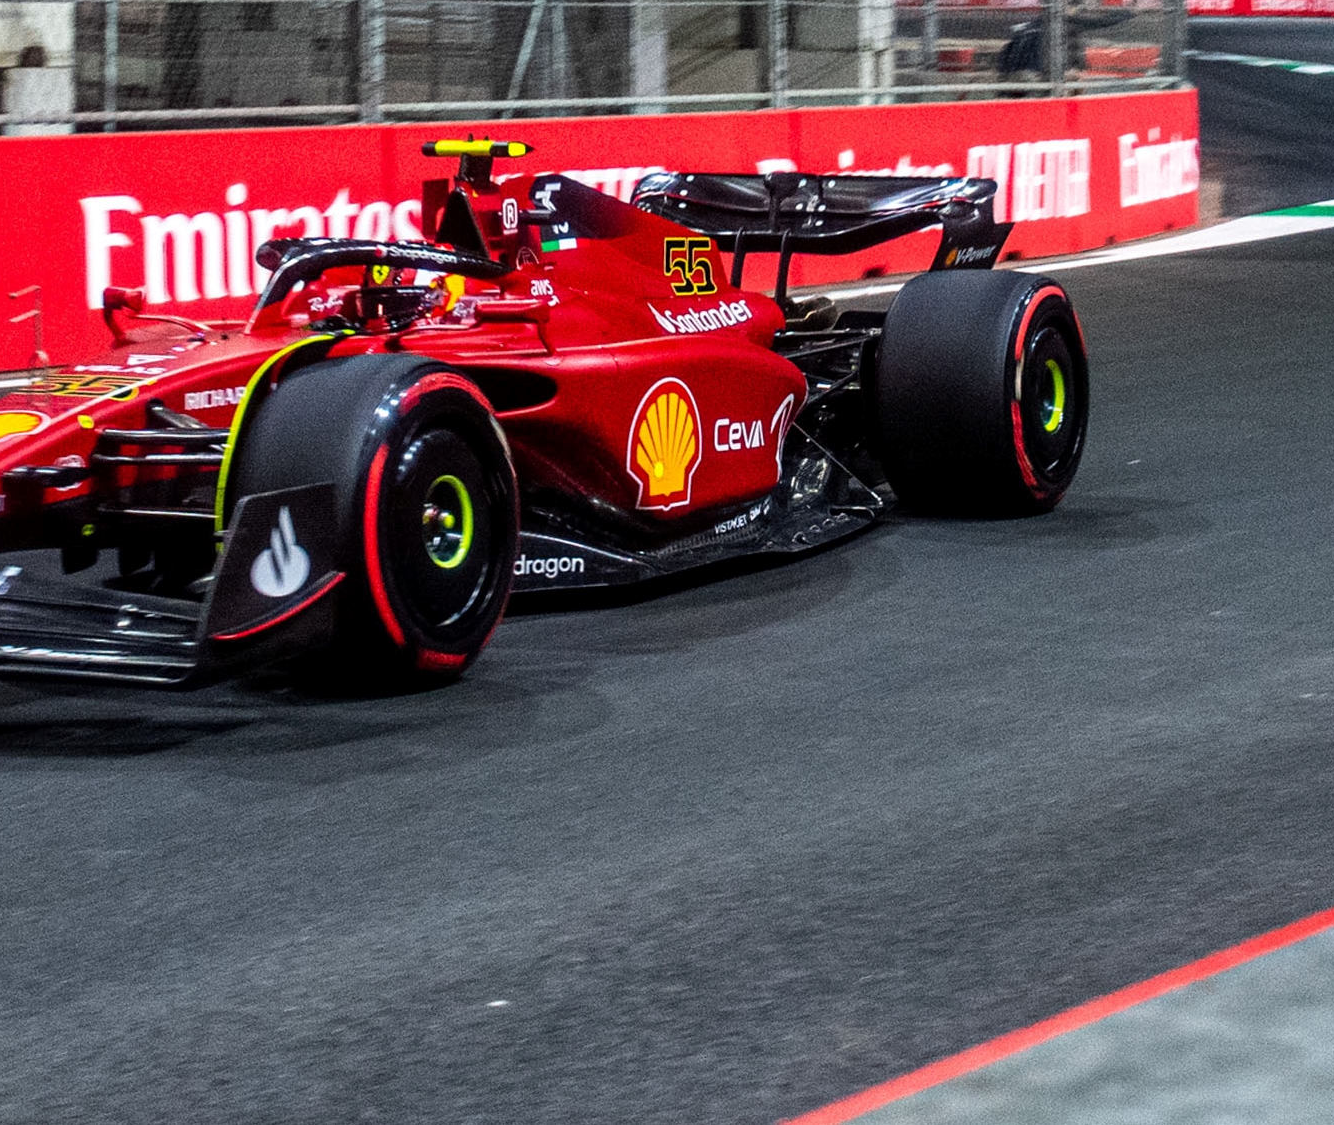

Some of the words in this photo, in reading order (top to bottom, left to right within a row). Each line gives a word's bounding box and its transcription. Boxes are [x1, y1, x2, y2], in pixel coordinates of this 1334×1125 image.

[664, 236, 718, 296] 55
[530, 279, 554, 297] aws
[663, 299, 753, 334] Santander
